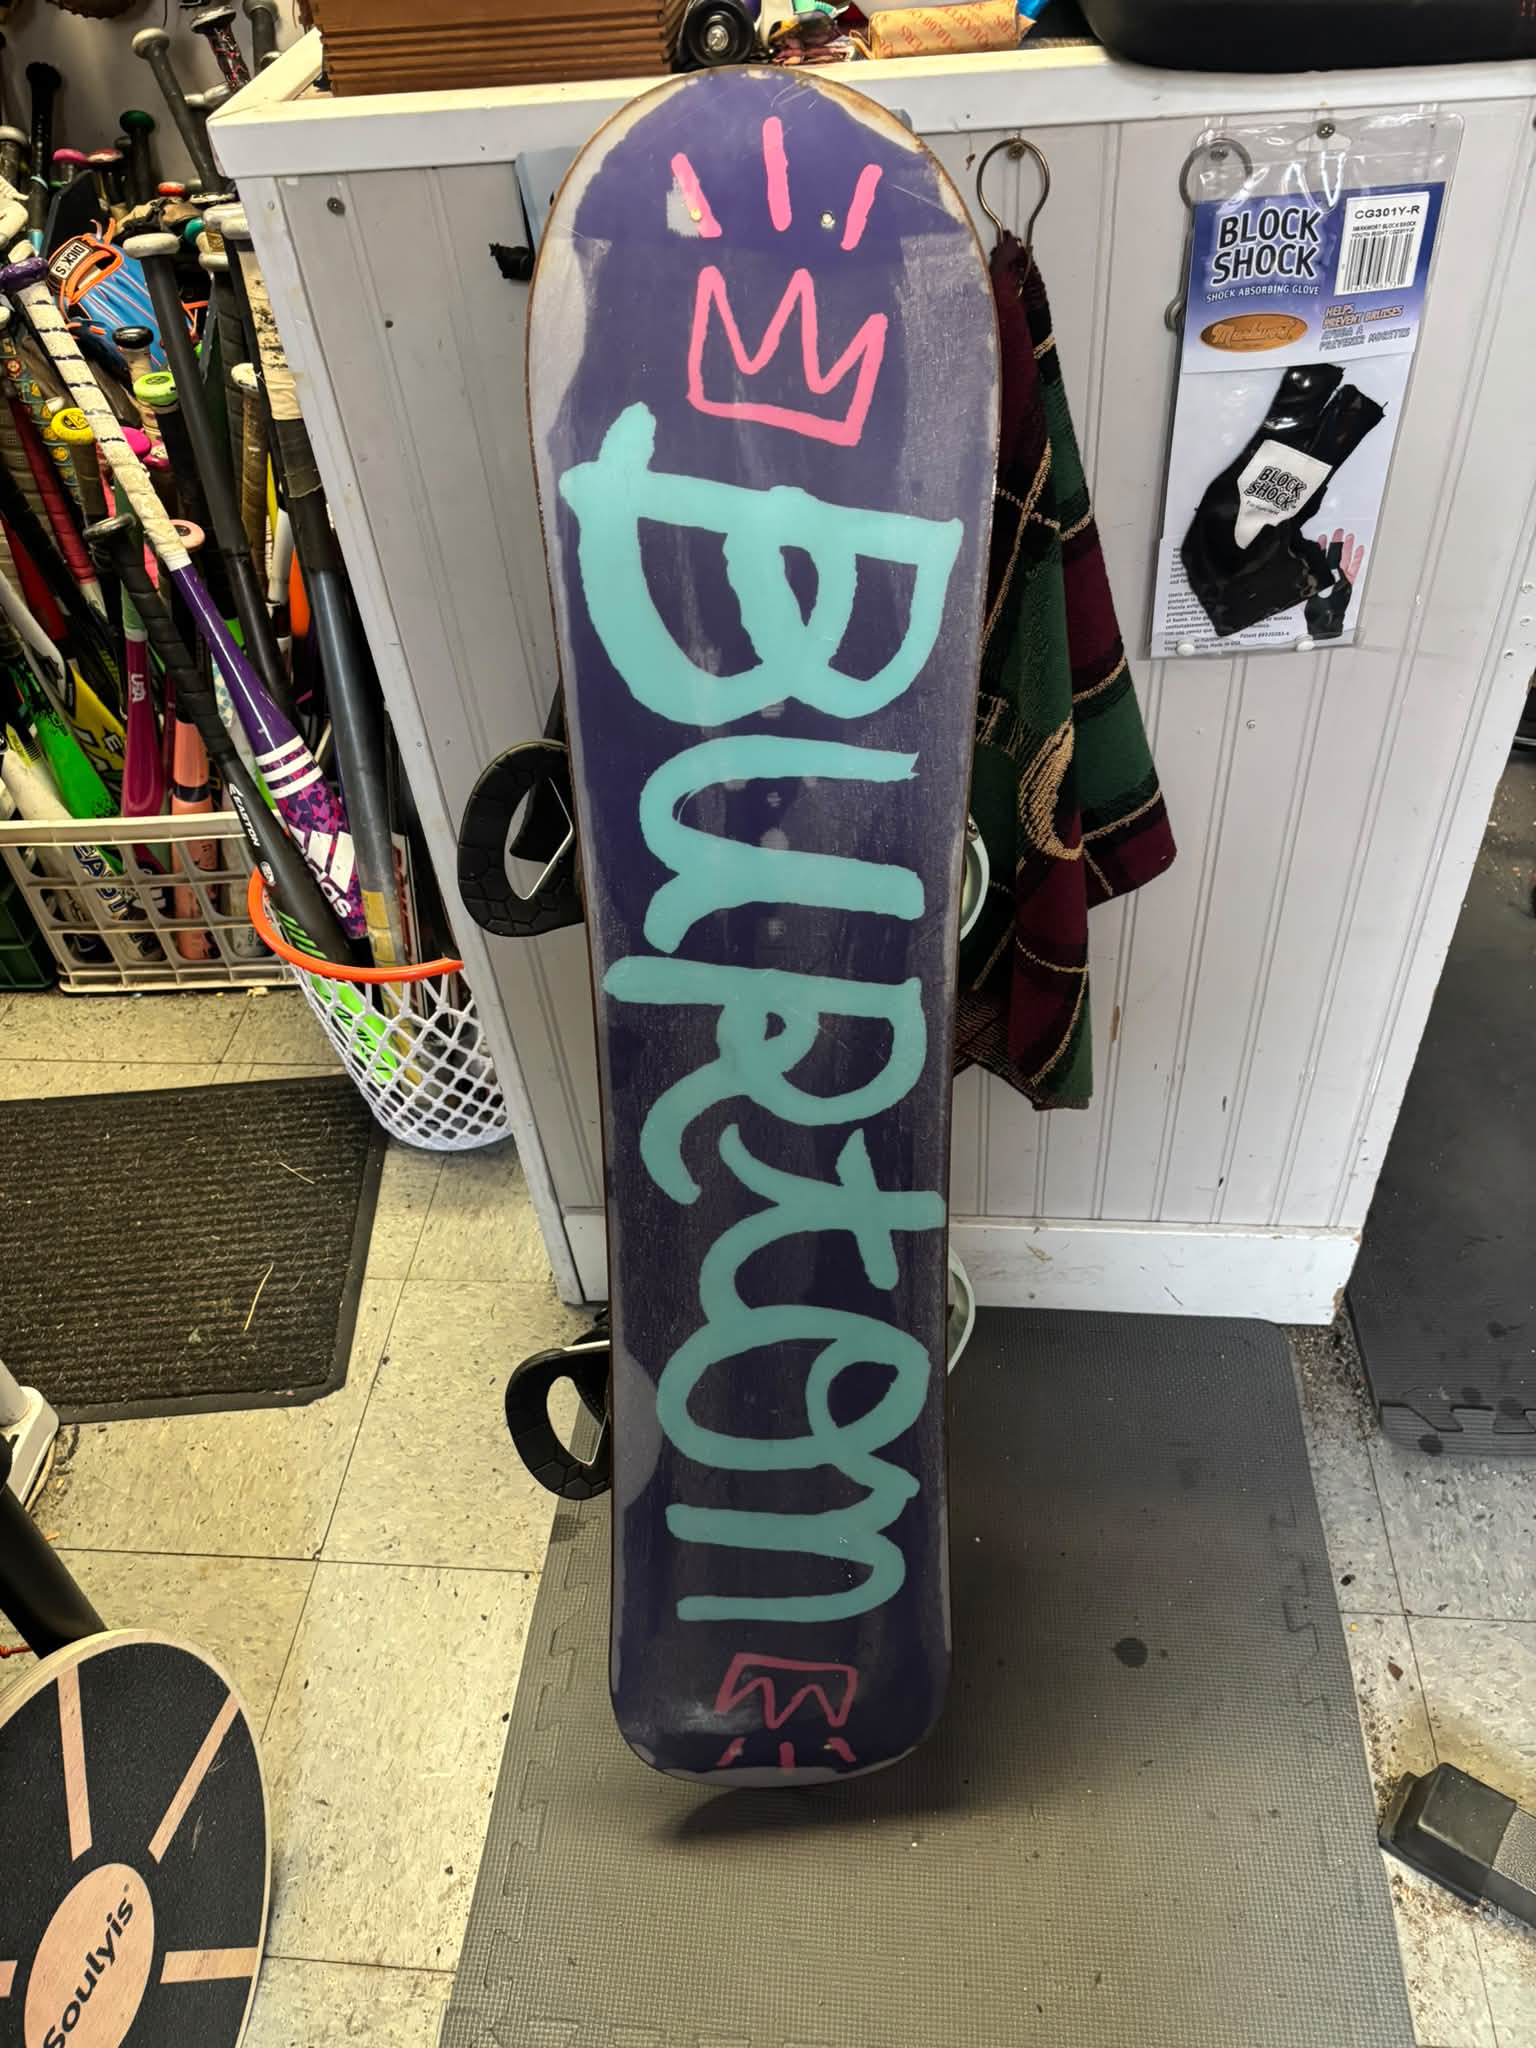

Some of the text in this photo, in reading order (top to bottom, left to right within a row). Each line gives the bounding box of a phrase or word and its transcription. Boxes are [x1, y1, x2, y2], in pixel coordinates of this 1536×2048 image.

[1354, 205, 1420, 219] CG301Y-R
[1218, 207, 1322, 250] BLOCK
[55, 244, 86, 275] DICK'S
[1211, 244, 1317, 285] SHOCK
[1206, 285, 1320, 303] SHOCK ABSORBING GLOVE
[1244, 481, 1297, 511] SHOCK
[1257, 466, 1307, 500] BLOCK
[233, 793, 261, 847] EASTON
